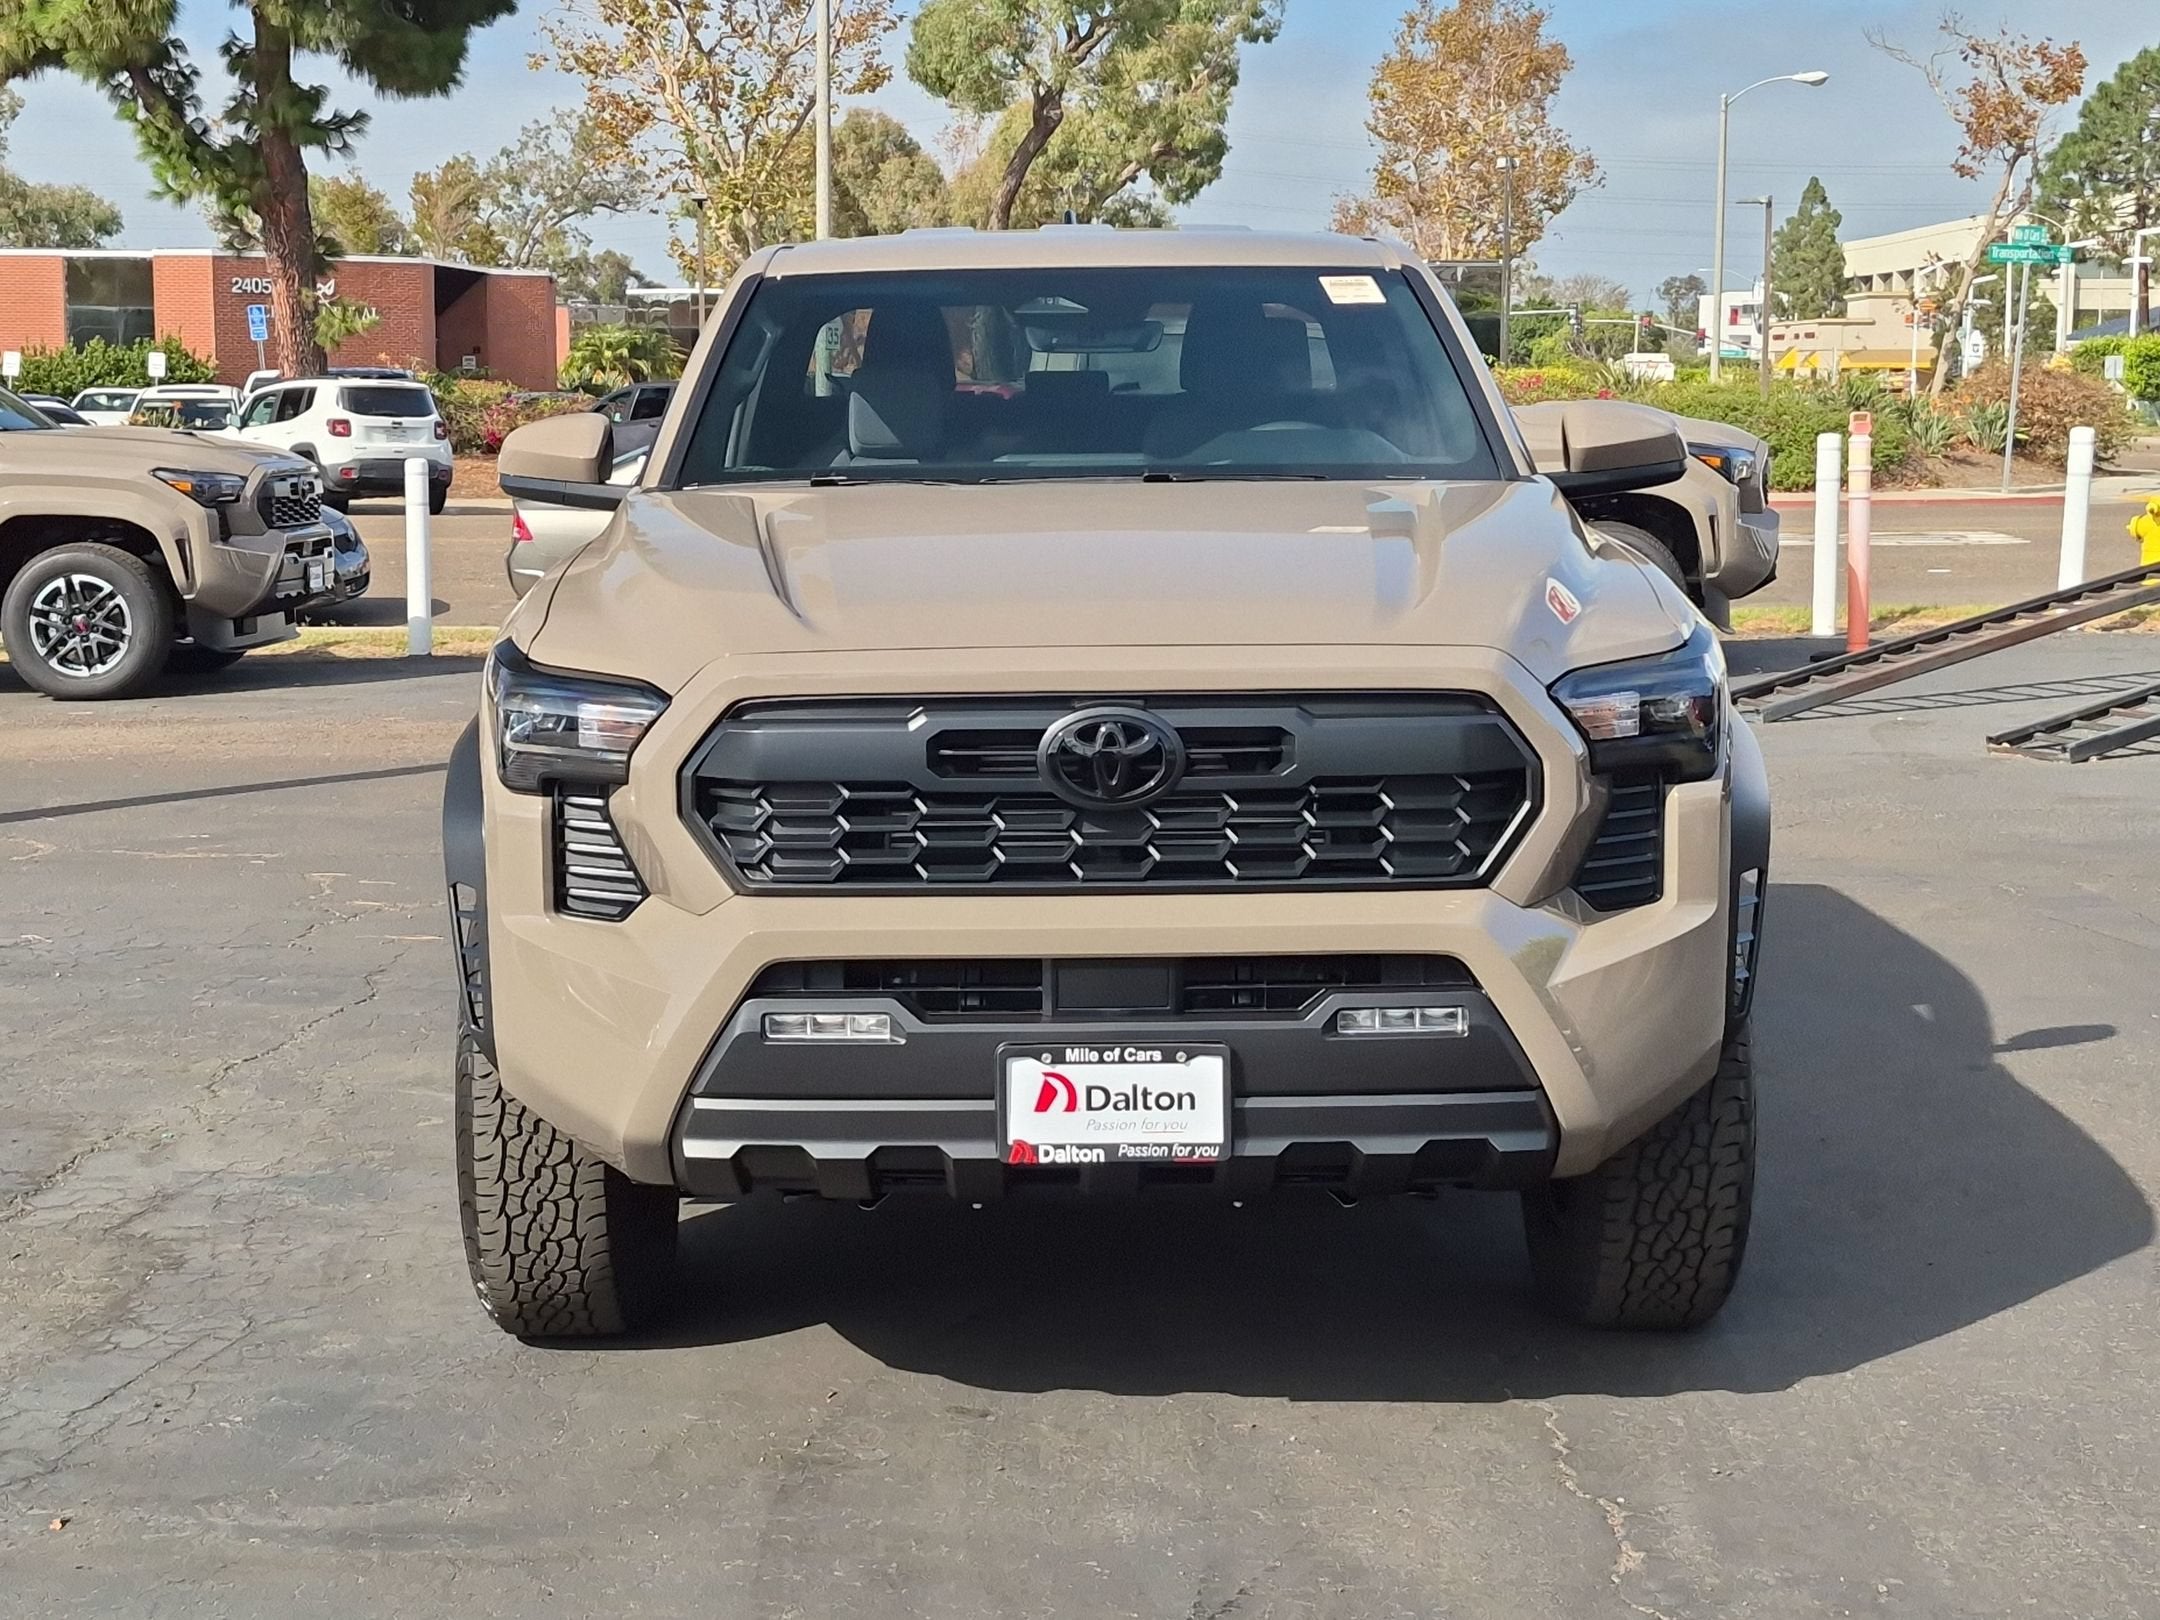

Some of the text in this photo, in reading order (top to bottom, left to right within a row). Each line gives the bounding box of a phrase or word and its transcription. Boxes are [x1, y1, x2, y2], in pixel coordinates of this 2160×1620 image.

[1992, 246, 2054, 261] Transportation
[231, 277, 272, 294] 2405
[827, 327, 839, 345] 35
[1065, 1047, 1162, 1062] Mile of Cars
[1085, 1083, 1196, 1111] Dalton
[1086, 1119, 1188, 1133] Passion for you
[1038, 1144, 1105, 1163] Dalton
[1118, 1143, 1220, 1160] Passion for you
